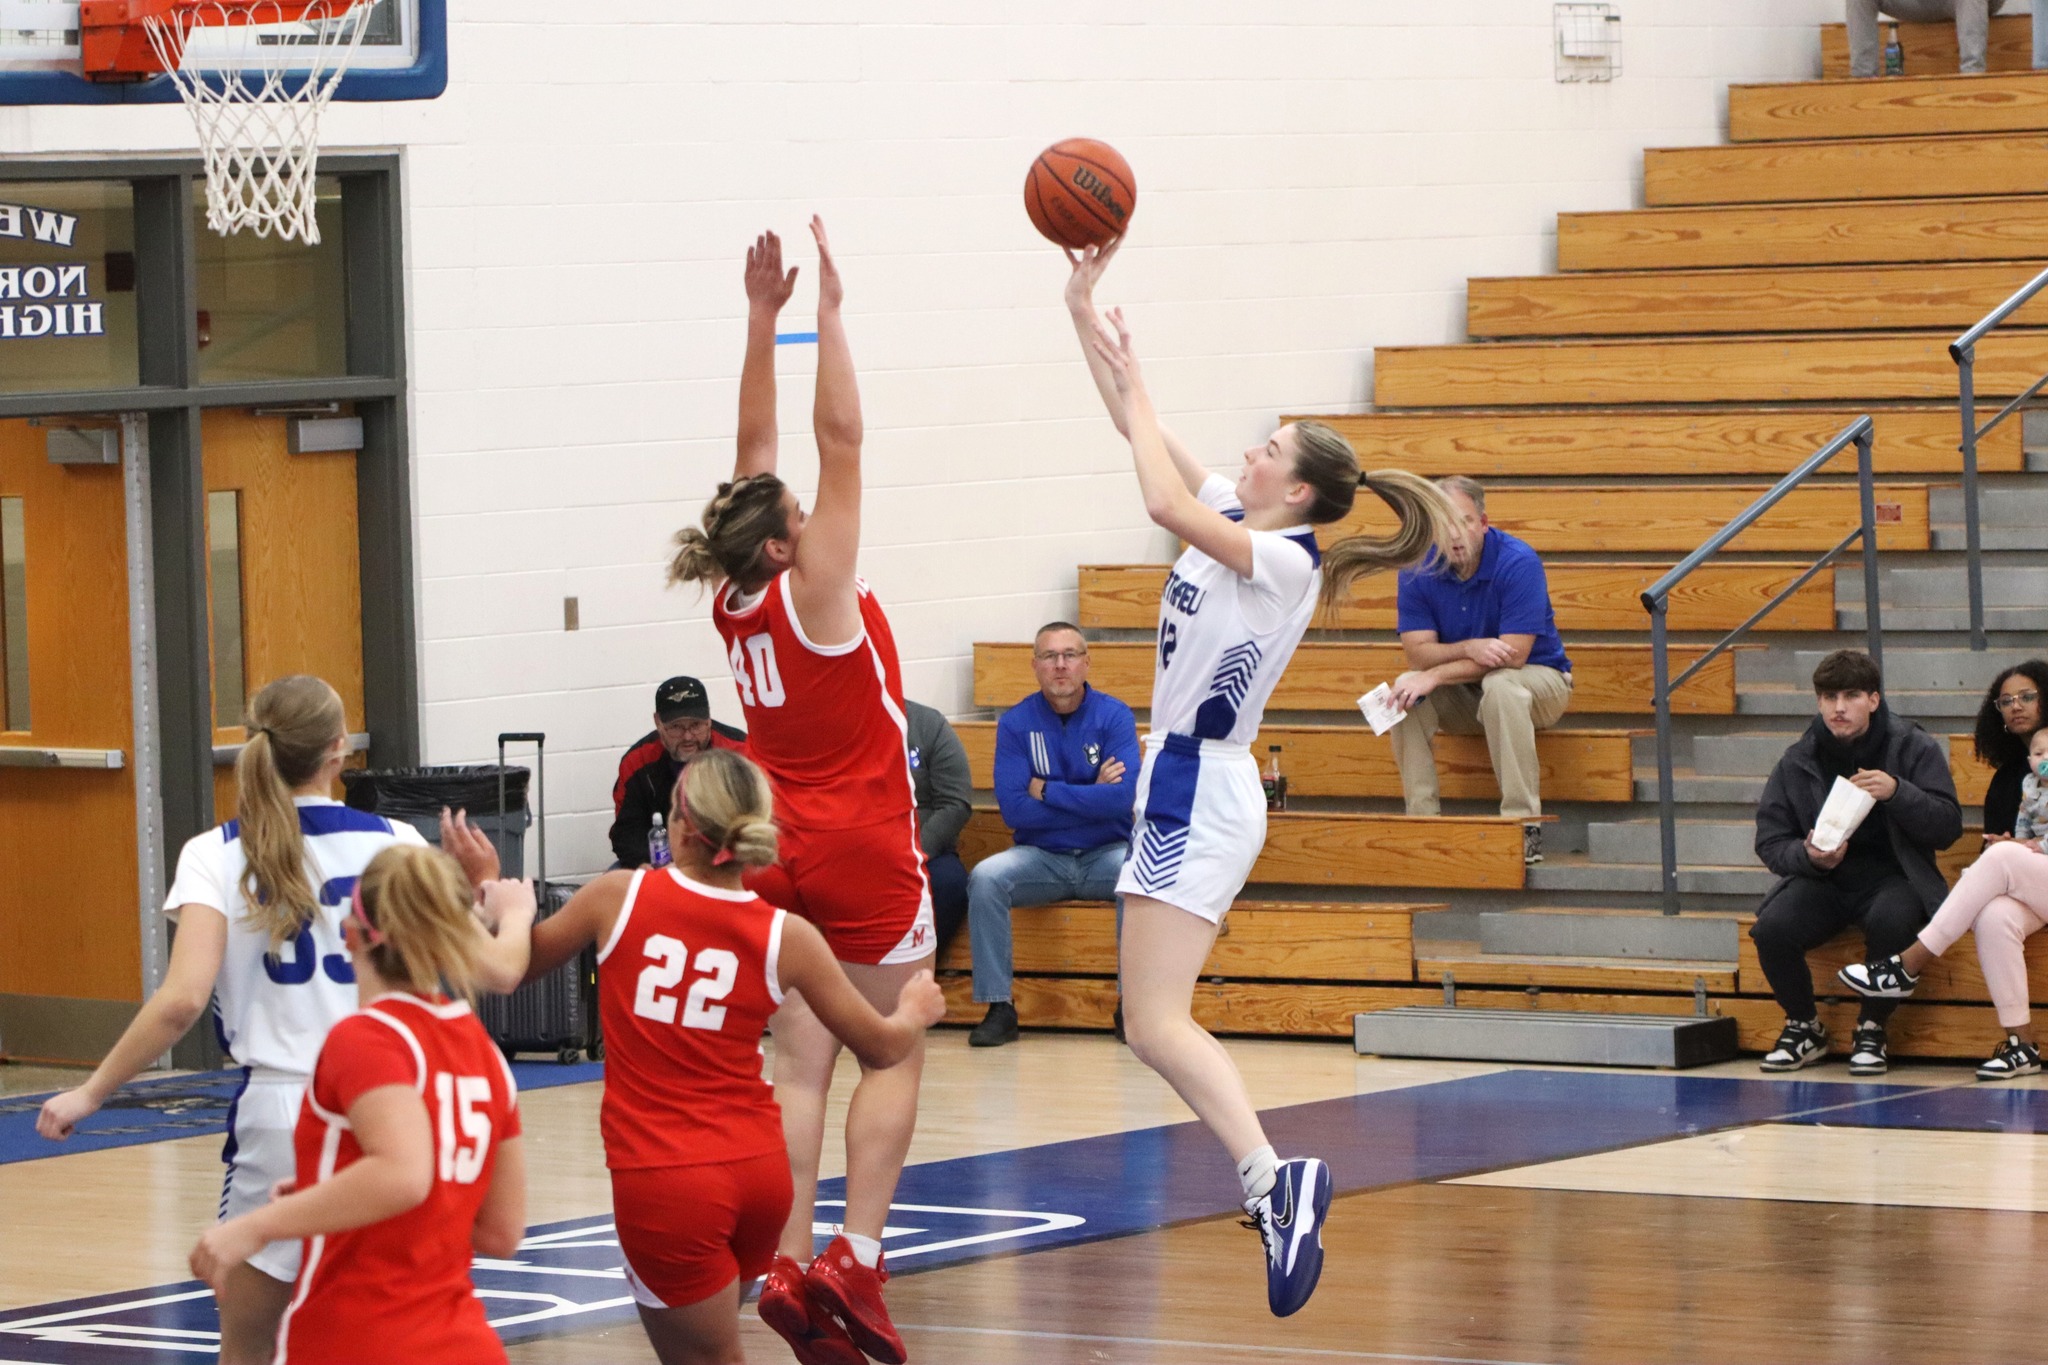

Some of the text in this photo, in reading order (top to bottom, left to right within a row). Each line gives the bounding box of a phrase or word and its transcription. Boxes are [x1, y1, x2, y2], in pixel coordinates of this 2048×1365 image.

[730, 632, 786, 708] 40
[633, 933, 739, 1031] 22
[435, 1070, 492, 1184] 15
